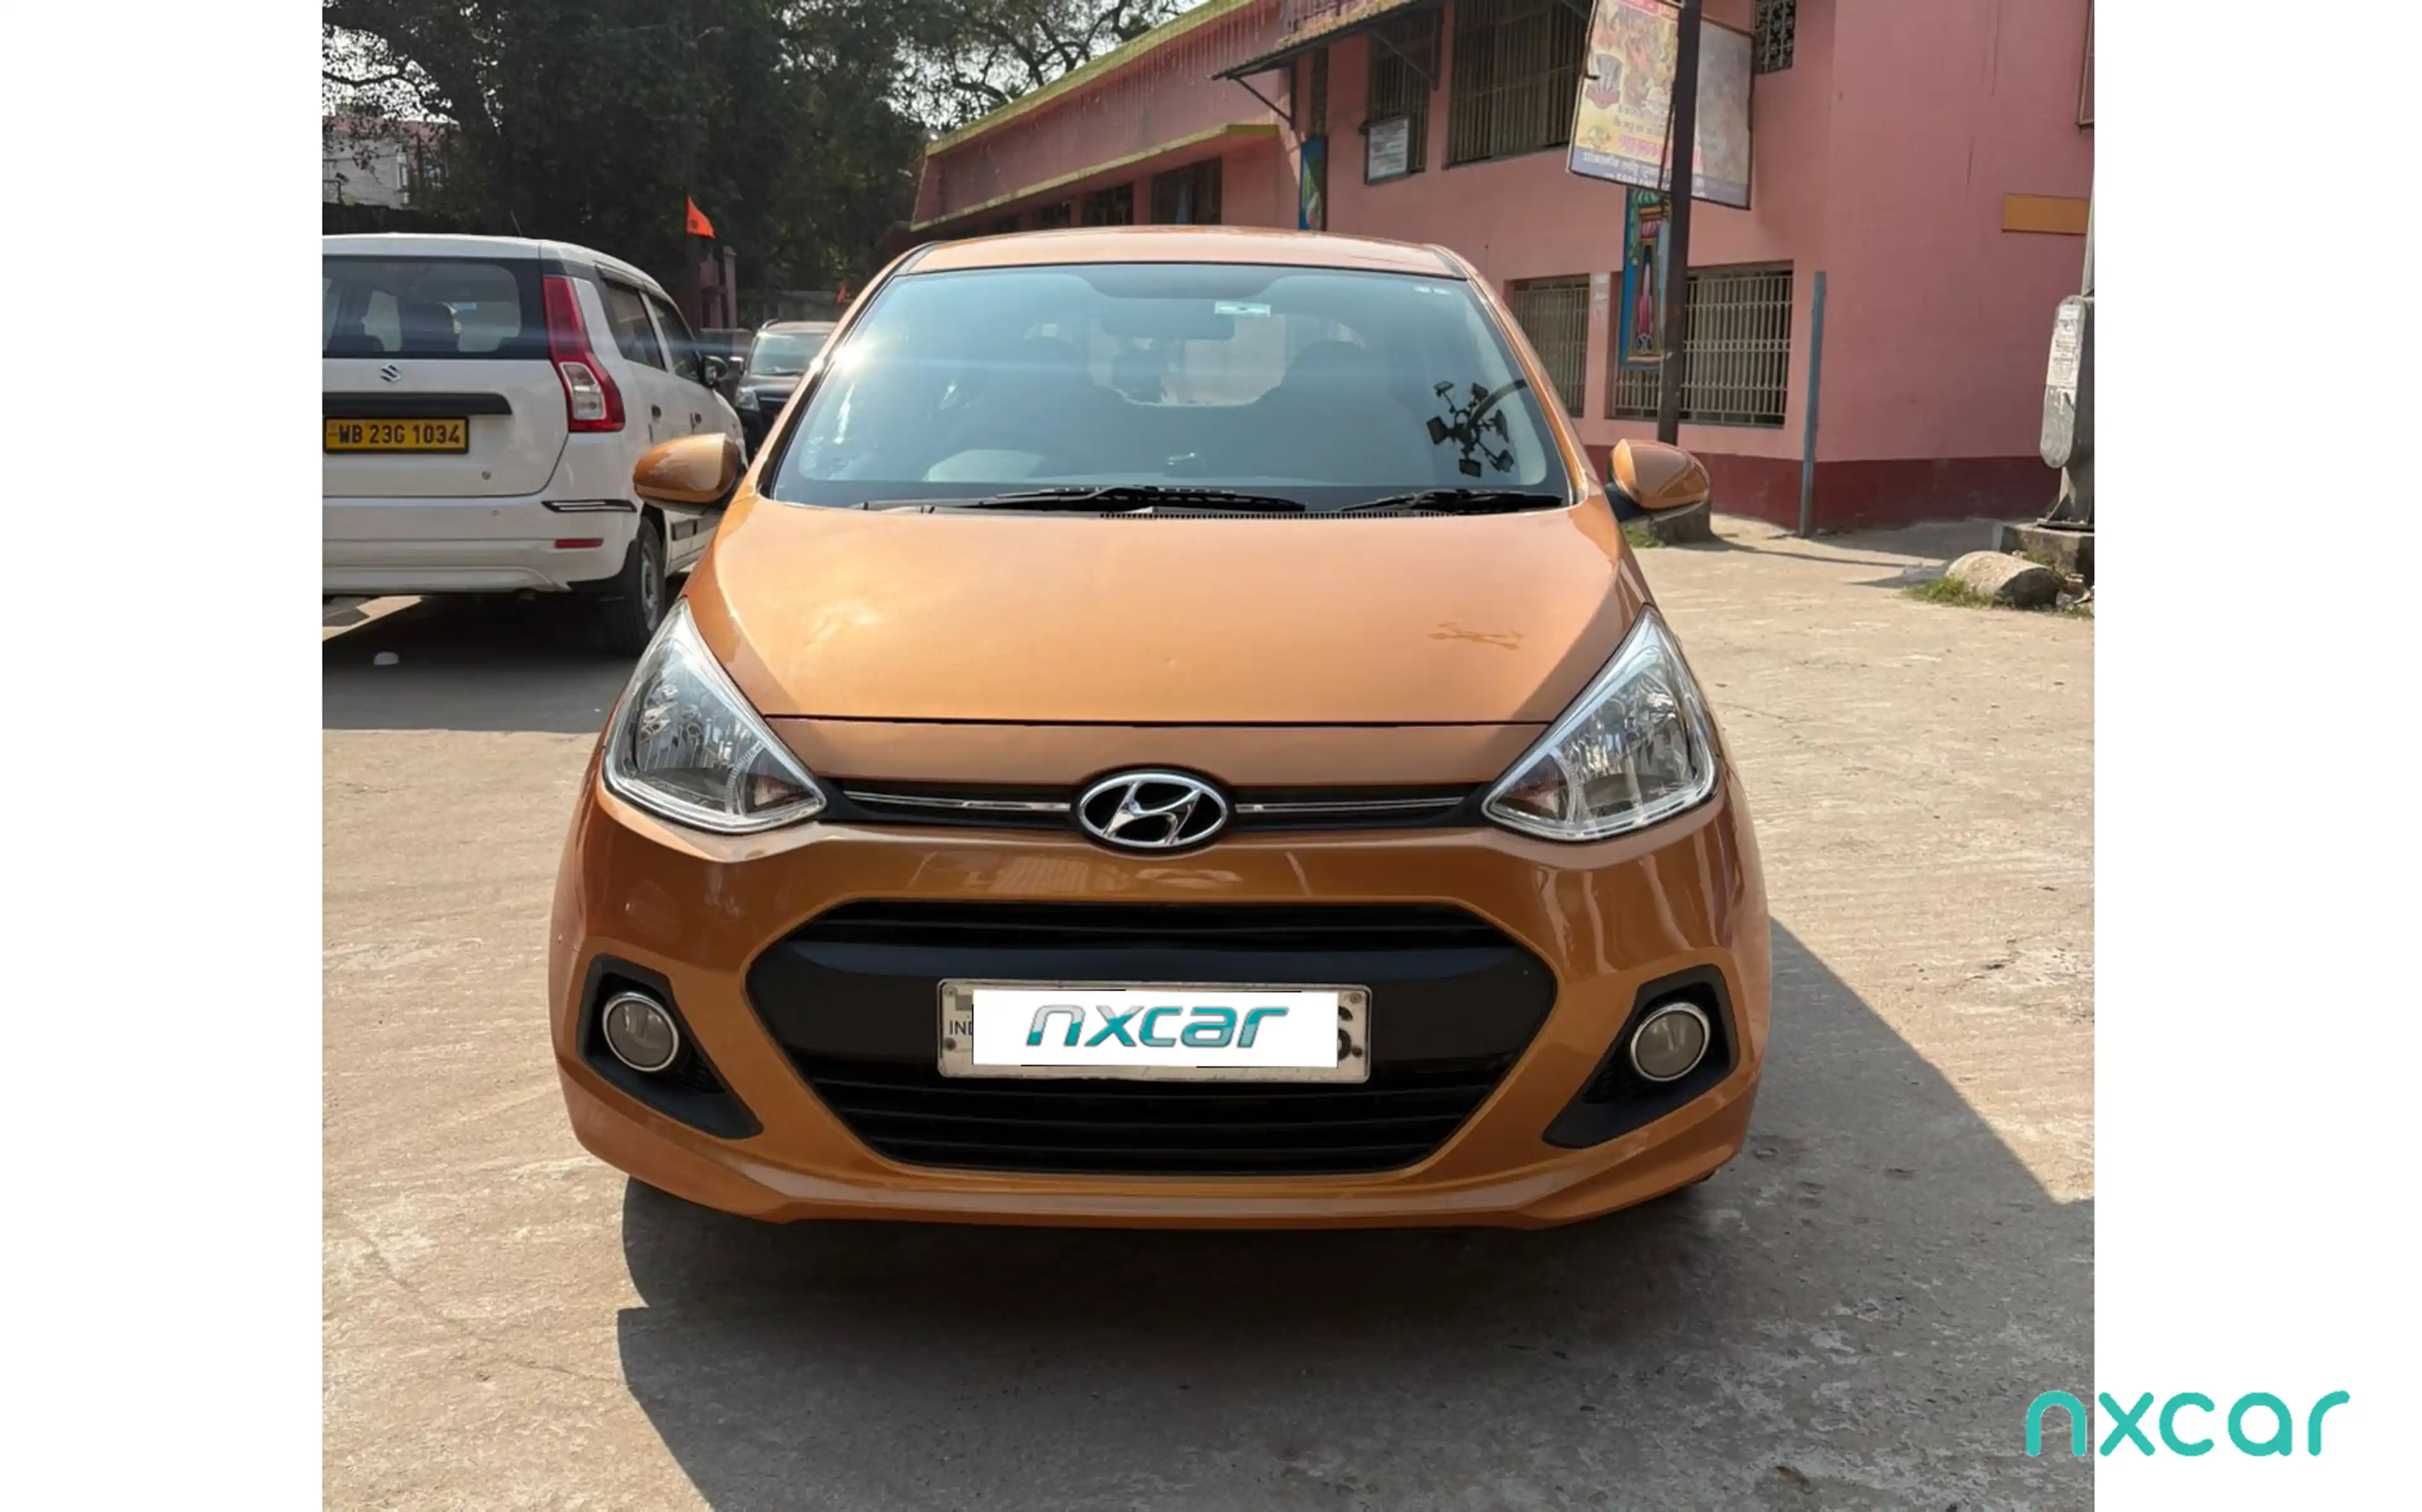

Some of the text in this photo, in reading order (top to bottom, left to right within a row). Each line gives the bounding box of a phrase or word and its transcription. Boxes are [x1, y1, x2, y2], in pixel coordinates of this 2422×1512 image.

[338, 423, 460, 445] WB 23G 1034
